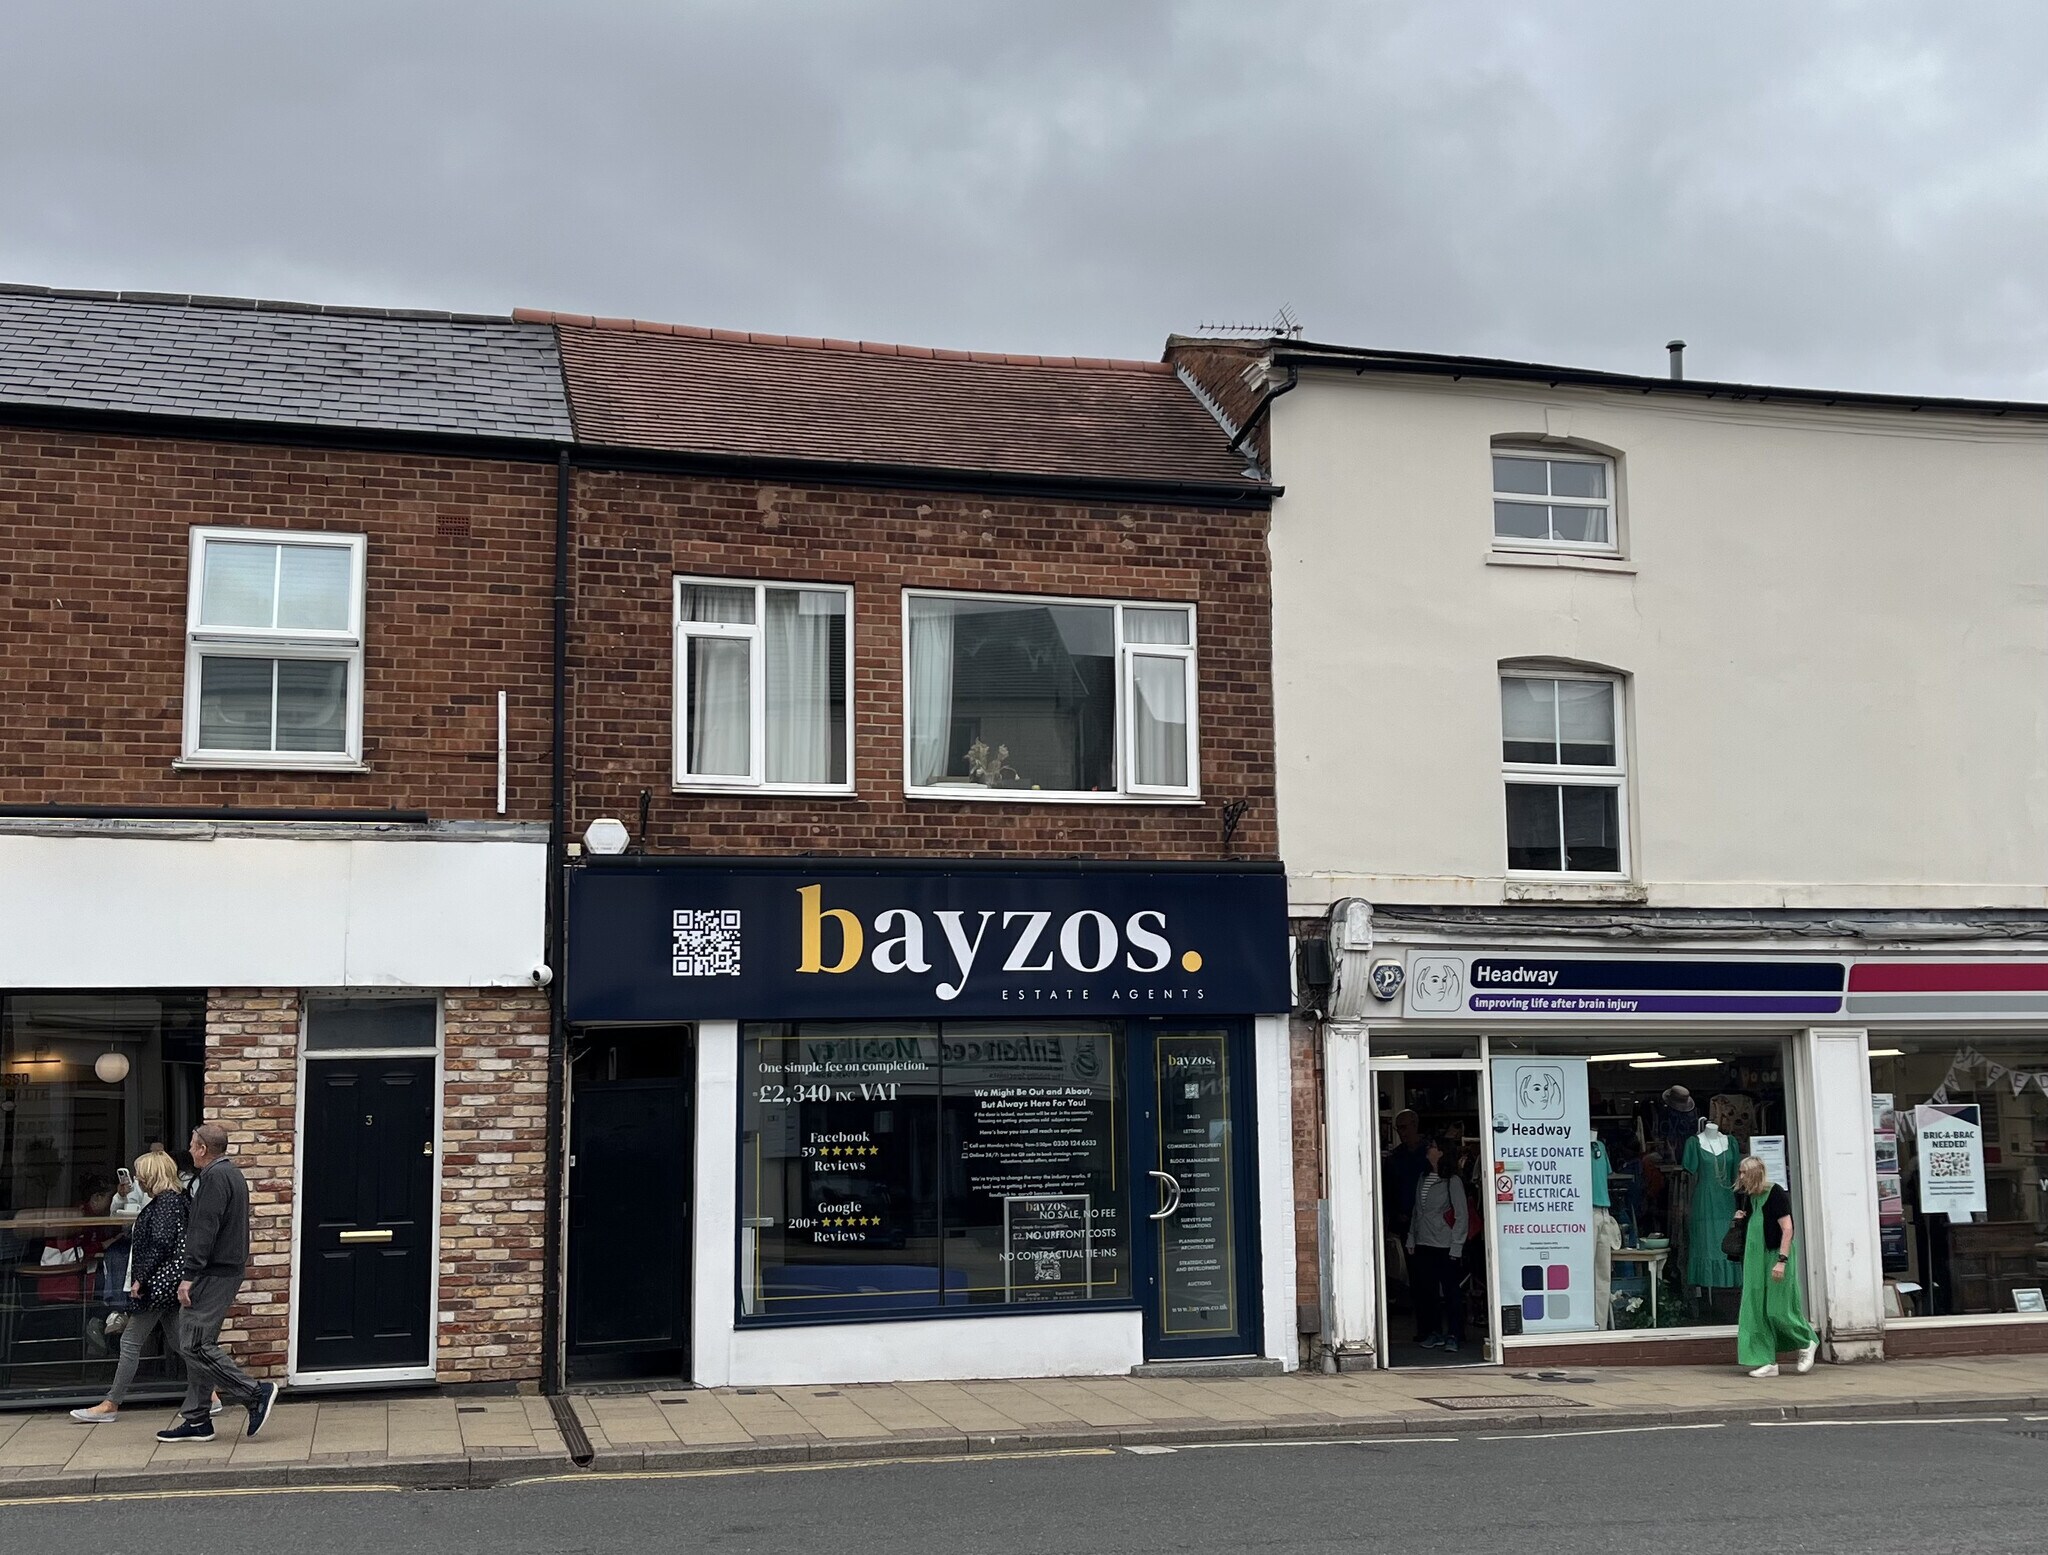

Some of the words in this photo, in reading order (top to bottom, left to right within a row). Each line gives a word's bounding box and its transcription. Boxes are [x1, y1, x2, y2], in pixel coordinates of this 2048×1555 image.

[796, 883, 1203, 1000] bayzos.
[1477, 966, 1558, 985] Headway
[1003, 989, 1090, 1000] ESTATE
[1112, 988, 1205, 1000] AGENTS
[1475, 997, 1529, 1011] improving
[1531, 997, 1549, 1009] life
[1551, 998, 1577, 1010] after
[1578, 998, 1605, 1010] brain
[1607, 998, 1638, 1012] injury
[1168, 1054, 1215, 1068] bayzos.
[759, 1062, 782, 1073] One
[784, 1062, 823, 1075] simple
[826, 1061, 844, 1072] fee
[845, 1063, 859, 1071] on
[860, 1060, 929, 1074] completion.
[759, 1083, 831, 1106] £2,340
[835, 1091, 856, 1102] INC
[860, 1083, 901, 1101] VAT
[974, 1089, 988, 1097] We
[990, 1088, 1014, 1098] Might
[1016, 1088, 1027, 1096] Be
[1028, 1088, 1045, 1096] Out
[1046, 1087, 1063, 1095] and
[1065, 1087, 1093, 1096] About,
[981, 1101, 996, 1109] But
[997, 1100, 1028, 1109] Always
[1030, 1099, 1051, 1107] Here
[1053, 1099, 1066, 1107] For
[365, 1115, 373, 1126] 3
[1512, 1122, 1571, 1139] Headway
[1923, 1131, 1974, 1139] BRIC-A-BRAC
[810, 1131, 870, 1143] Facebook
[1932, 1140, 1967, 1148] NEEDED!
[801, 1147, 816, 1157] 59
[1501, 1148, 1538, 1158] PLEASE
[1541, 1147, 1584, 1157] DONATE
[814, 1160, 866, 1172] Reviews
[1527, 1161, 1557, 1171] YOUR
[1514, 1174, 1572, 1185] FURNITURE
[1518, 1188, 1580, 1198] ELECTRICAL
[818, 1201, 862, 1215] Google
[1513, 1202, 1545, 1212] ITEMS
[1547, 1202, 1574, 1211] HERE
[1040, 1211, 1055, 1219] NO
[1058, 1210, 1081, 1220] SALE,
[1083, 1209, 1099, 1218] NO
[1101, 1208, 1116, 1217] FEE
[788, 1218, 819, 1229] 200+
[1503, 1224, 1524, 1234] FREE
[1527, 1224, 1586, 1233] COLLECTION
[814, 1231, 866, 1242] Reviews
[1025, 1231, 1041, 1240] NO
[1044, 1229, 1085, 1240] UPFRONT
[1088, 1228, 1116, 1238] COSTS
[999, 1253, 1014, 1261] NO
[1017, 1250, 1083, 1261] CONTRACTUAL
[1085, 1248, 1117, 1258] TIE-INS
